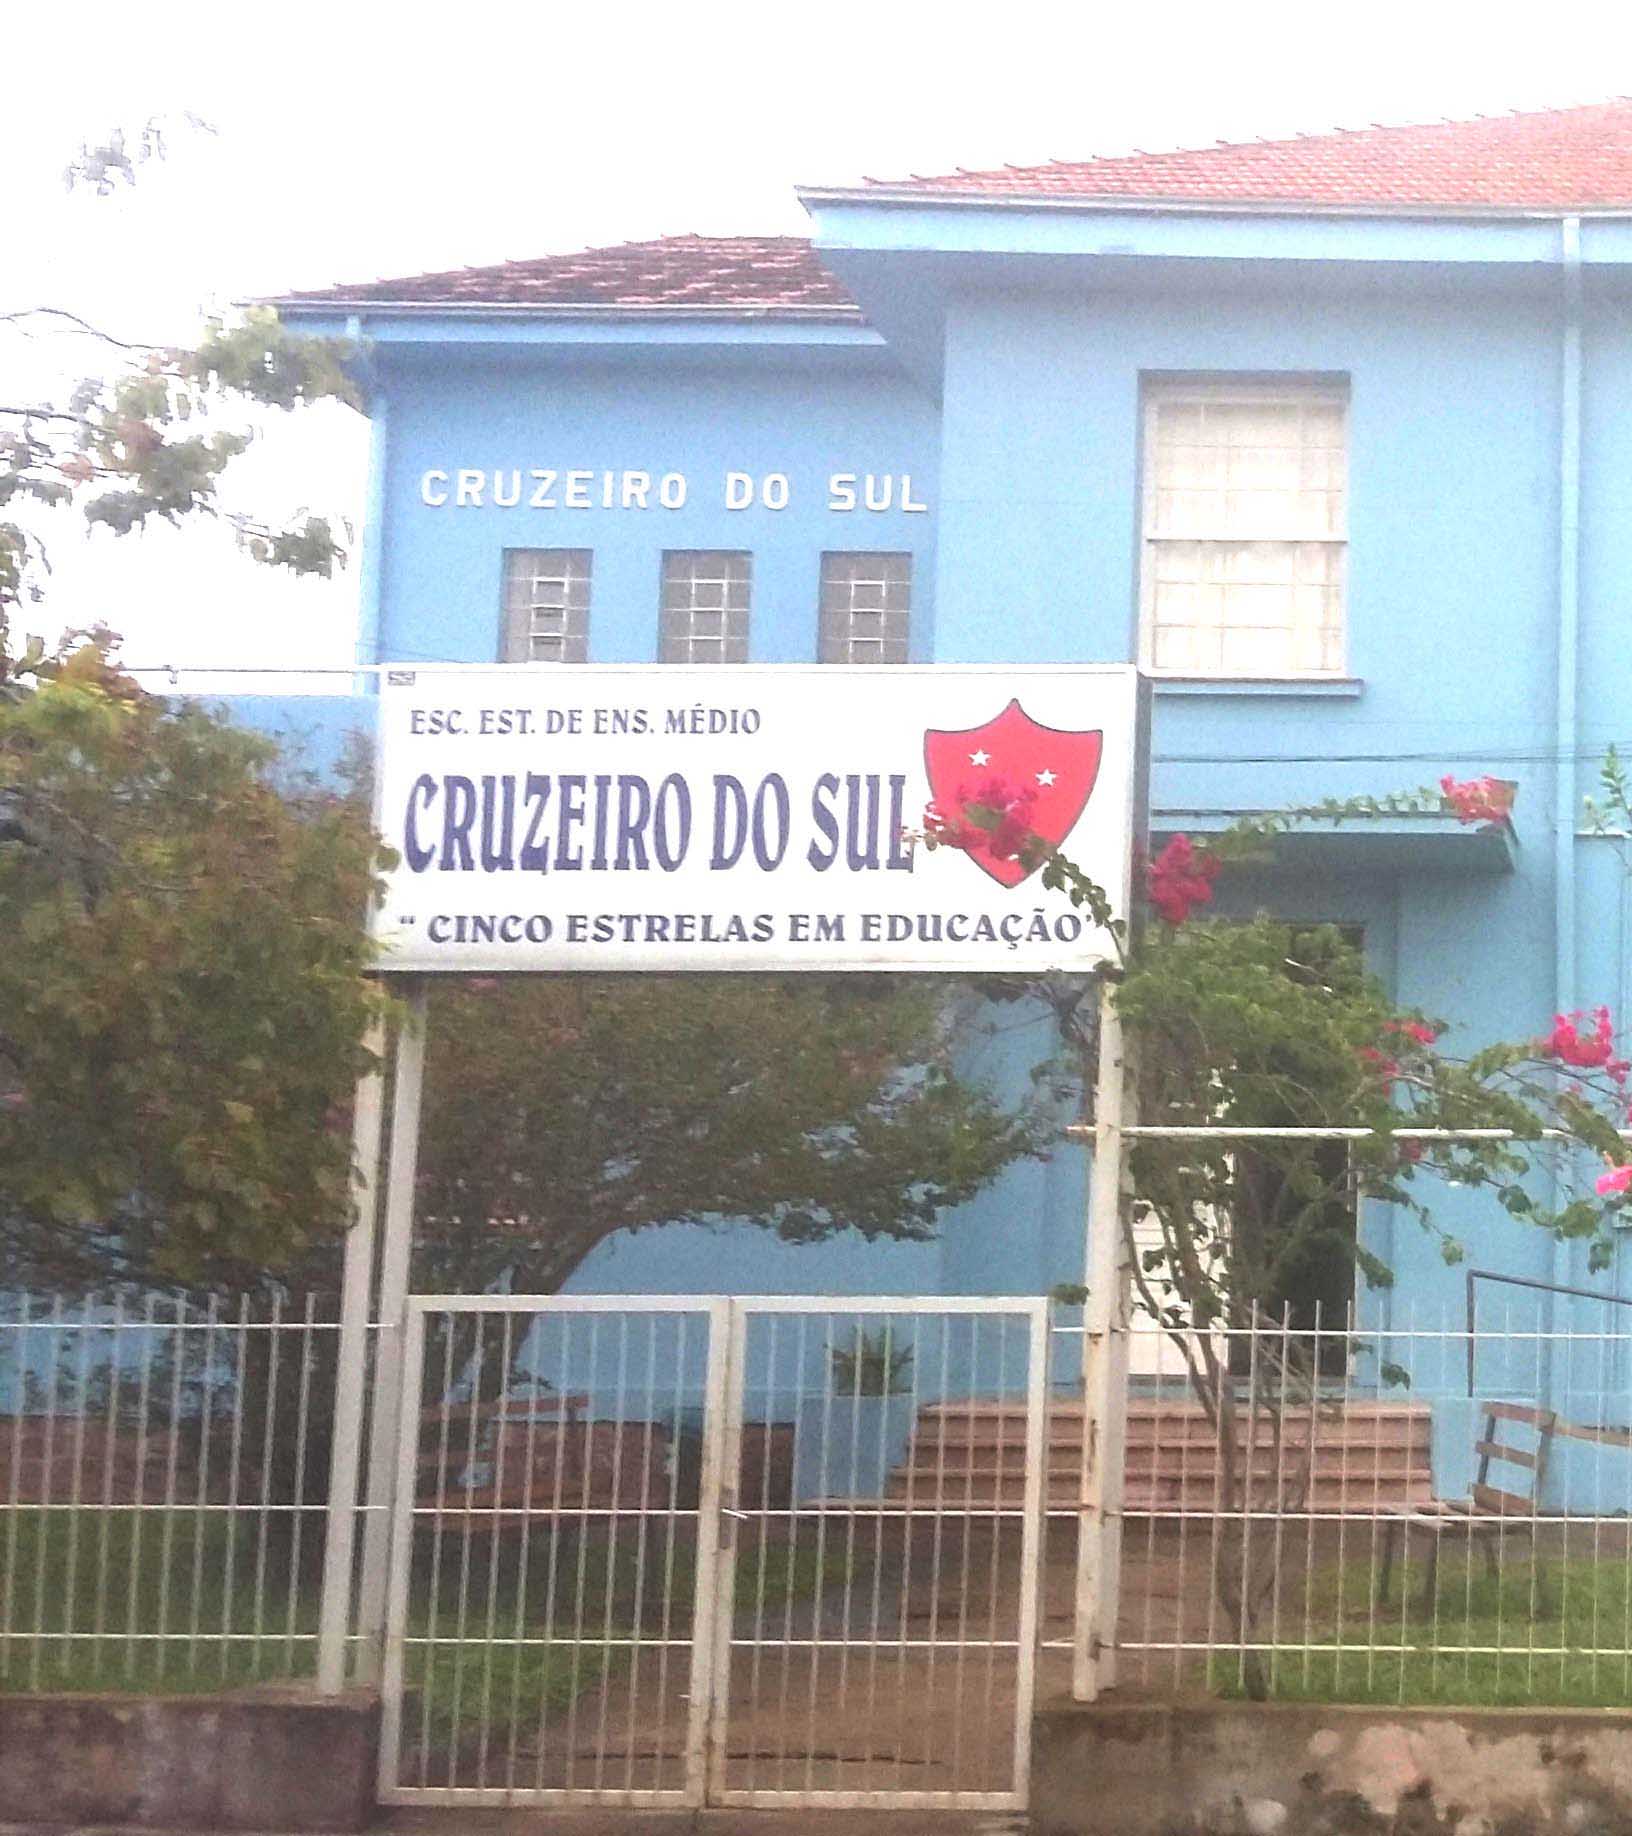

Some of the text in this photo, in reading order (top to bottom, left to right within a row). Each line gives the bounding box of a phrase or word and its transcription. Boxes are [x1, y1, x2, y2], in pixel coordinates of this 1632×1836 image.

[420, 469, 928, 513] CRUZEIRO DO SUL
[410, 703, 761, 735] ESC. EST. DE ENS. MÉDIO
[403, 771, 915, 875] CRUZEIRO DO SUL
[427, 914, 554, 943] CINCO
[565, 913, 775, 943] ESTRELAS
[788, 914, 846, 942] EM
